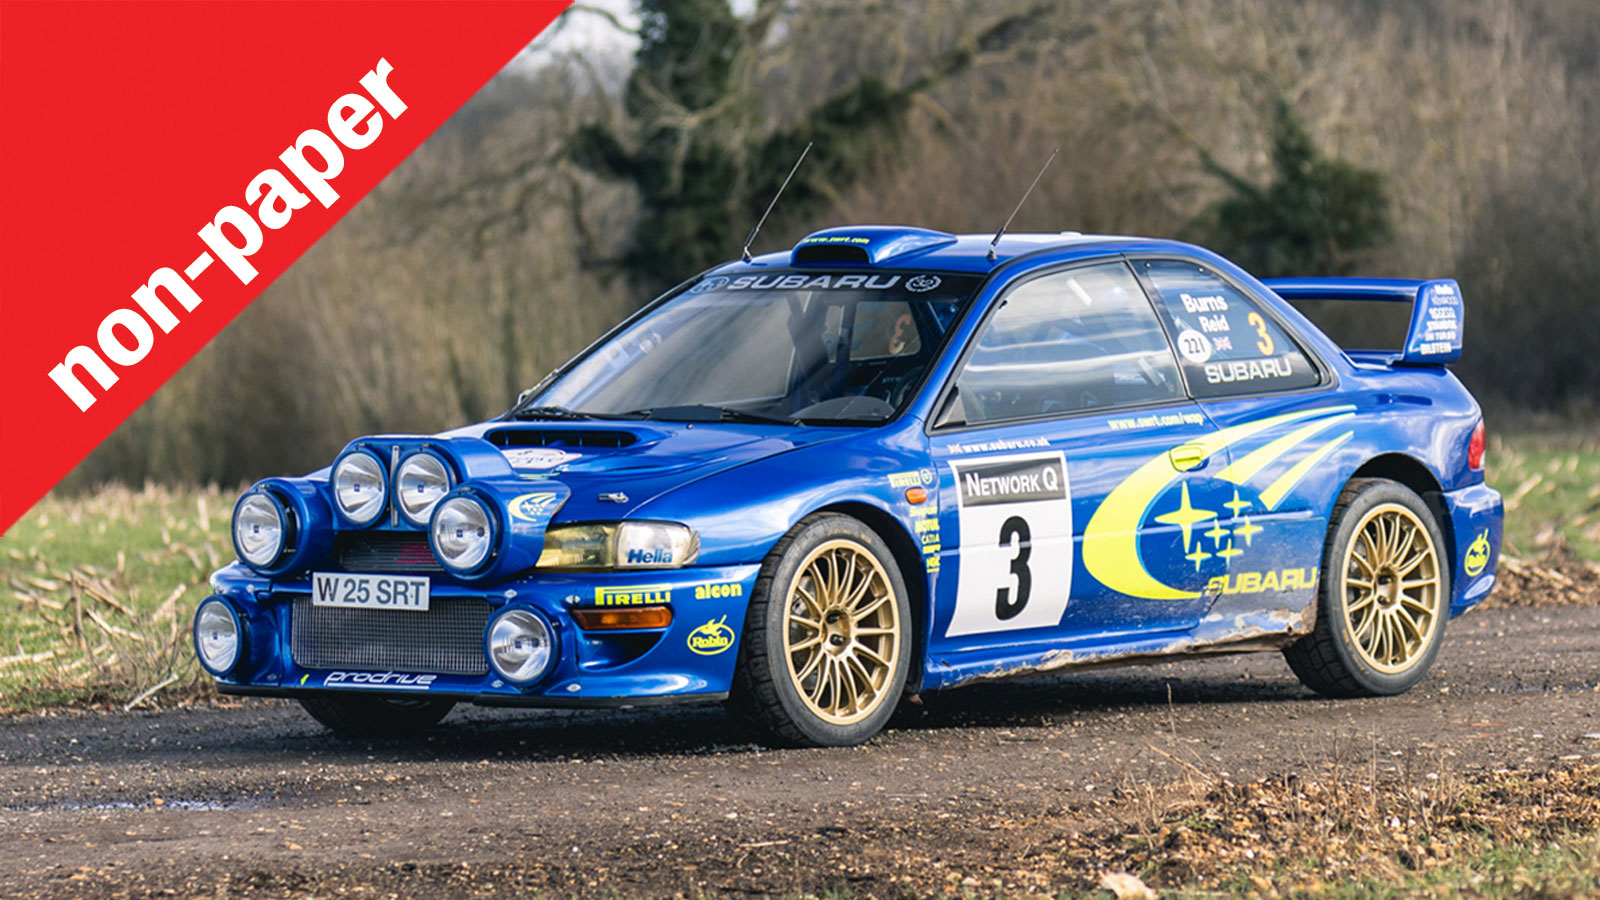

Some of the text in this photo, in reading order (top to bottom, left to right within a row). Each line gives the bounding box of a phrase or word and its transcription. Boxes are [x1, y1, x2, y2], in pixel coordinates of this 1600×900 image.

[727, 275, 901, 289] SUBARU
[1180, 294, 1228, 313] Burns
[1198, 314, 1230, 333] Reid
[1247, 312, 1275, 356] 3
[1204, 357, 1292, 384] SUBARU
[1107, 411, 1204, 430] www.swrt.com/wap
[965, 466, 1058, 497] NETWORK Q
[627, 549, 672, 564] Hella
[995, 515, 1032, 621] 3
[1205, 567, 1318, 595] SUBARU
[316, 577, 426, 606] W 25 SRT
[595, 583, 672, 606] PIRELLI
[695, 583, 742, 600] alcon
[692, 635, 729, 649] Robin
[323, 670, 438, 687] prodrive
